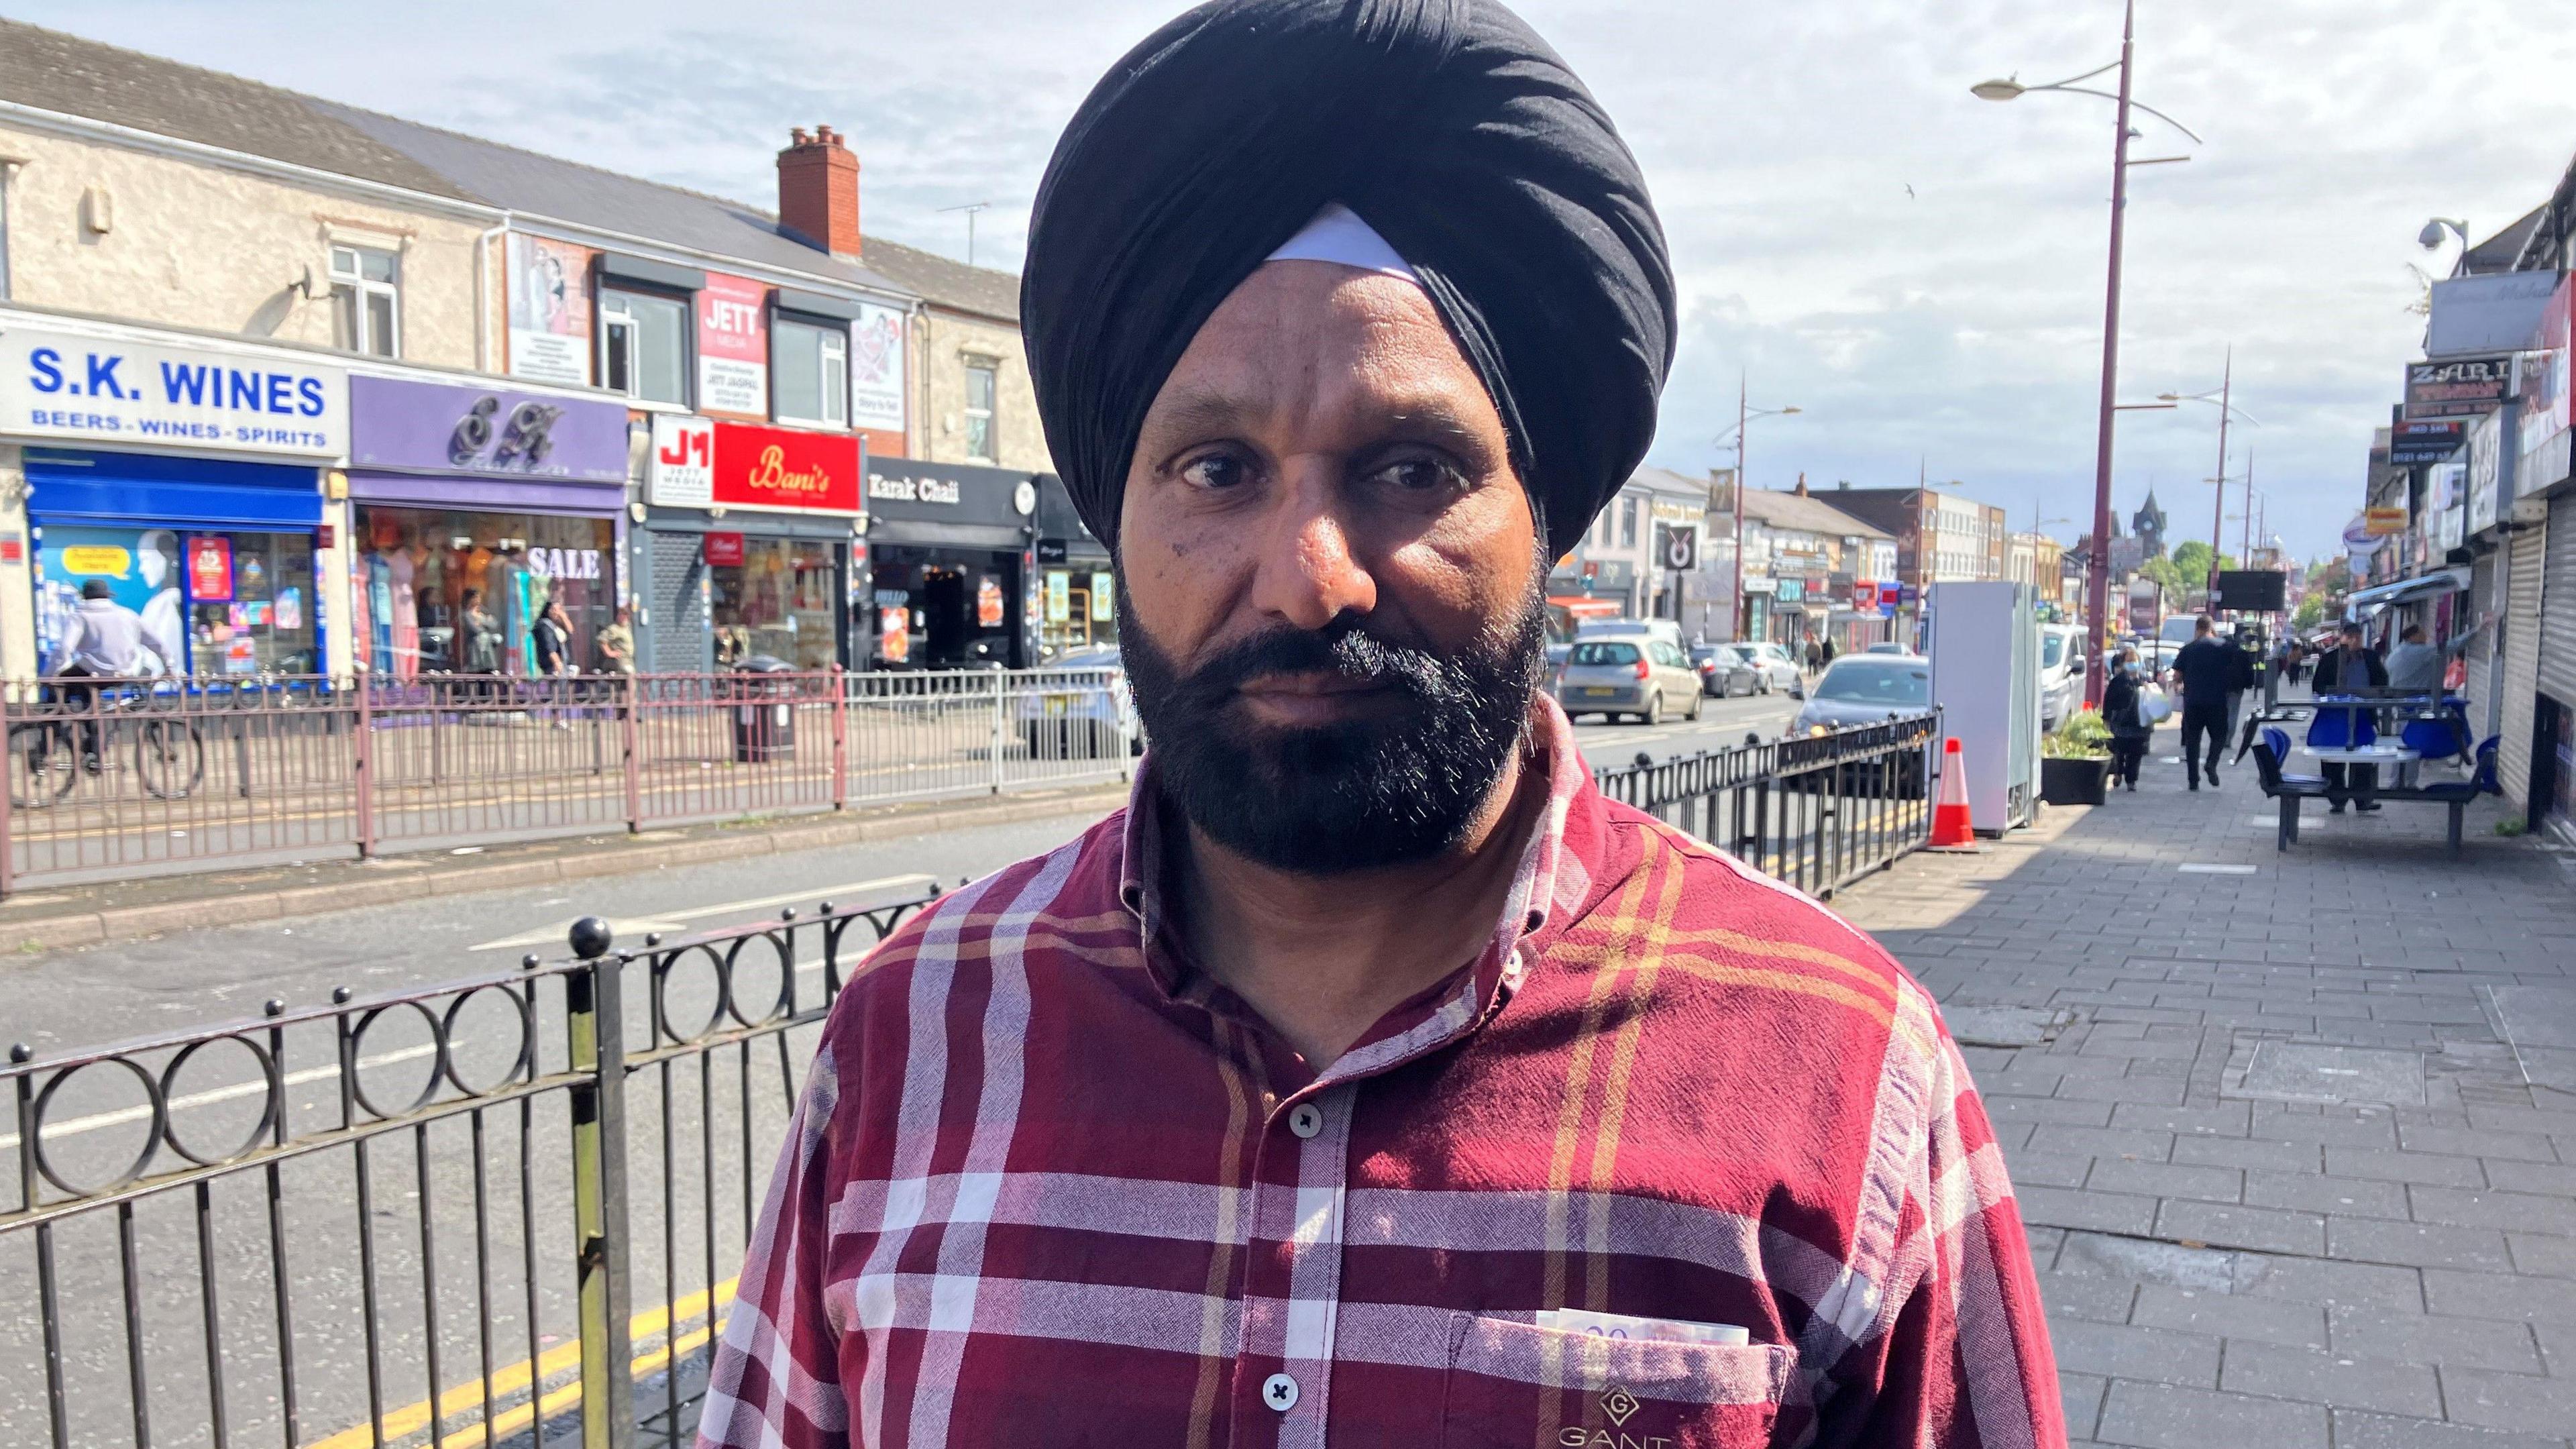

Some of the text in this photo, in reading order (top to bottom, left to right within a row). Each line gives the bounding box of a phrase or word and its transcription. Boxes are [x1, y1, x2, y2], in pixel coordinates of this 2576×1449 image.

[704, 299, 758, 336] JETT
[30, 347, 325, 417] S.K. WINES
[31, 409, 121, 431] BEERS
[138, 418, 221, 439] WINES
[237, 426, 327, 447] SPIRITS
[749, 444, 830, 492] Bani's
[868, 474, 916, 500] Karak
[527, 547, 600, 579] SALE
[1610, 1393, 1629, 1413] G
[1558, 1426, 1672, 1449] GANT
